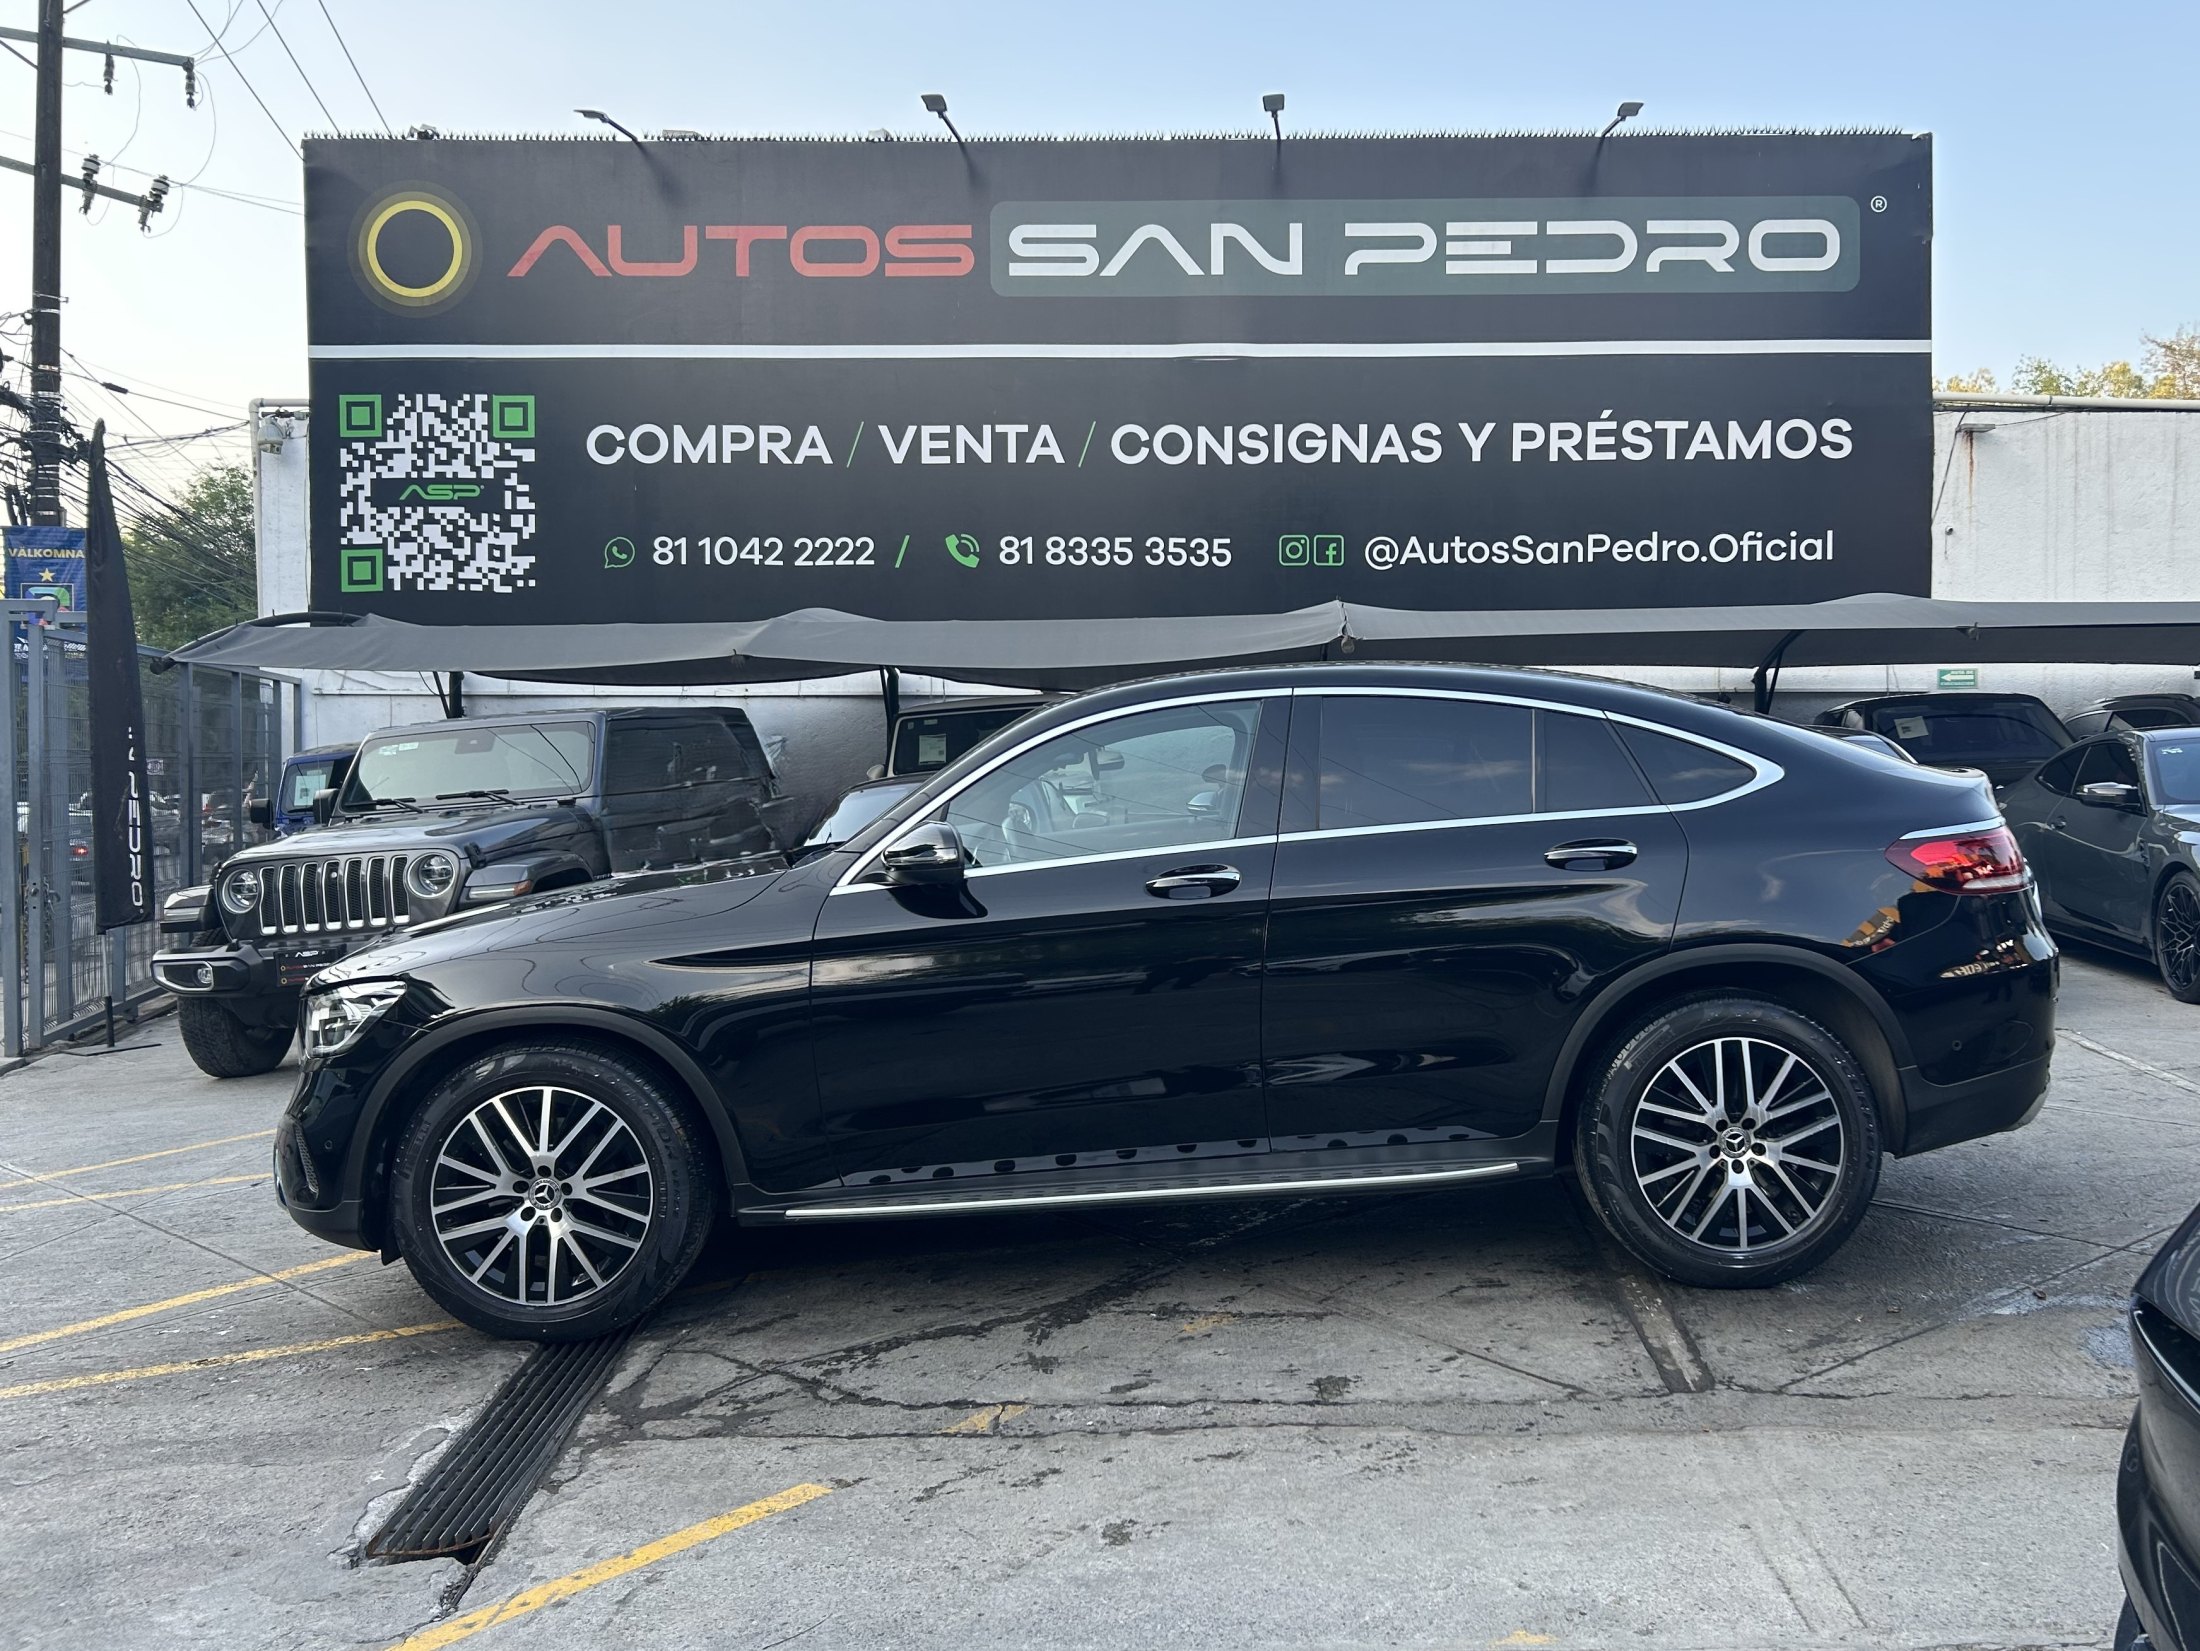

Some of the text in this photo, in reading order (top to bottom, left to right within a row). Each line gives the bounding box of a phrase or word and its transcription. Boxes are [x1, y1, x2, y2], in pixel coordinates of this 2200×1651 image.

[507, 224, 975, 278] AUTOS
[1008, 222, 1303, 277] SAN
[1344, 218, 1841, 276] PEDRO
[586, 423, 834, 465] COMPRA
[877, 424, 1066, 465] VENTA
[1110, 422, 1443, 465] CONSIGNAS
[1458, 422, 1496, 462] Y
[1512, 409, 1853, 463] PRÉSTAMOS
[399, 484, 481, 501] ASP
[8, 546, 86, 559] VÄLKOMNA
[652, 536, 686, 566] 81
[698, 536, 783, 566] 1042
[793, 536, 875, 566] 2222
[999, 535, 1232, 567] 81 8335 3535
[1364, 529, 1834, 571] @AutosSanPedro.Oficial
